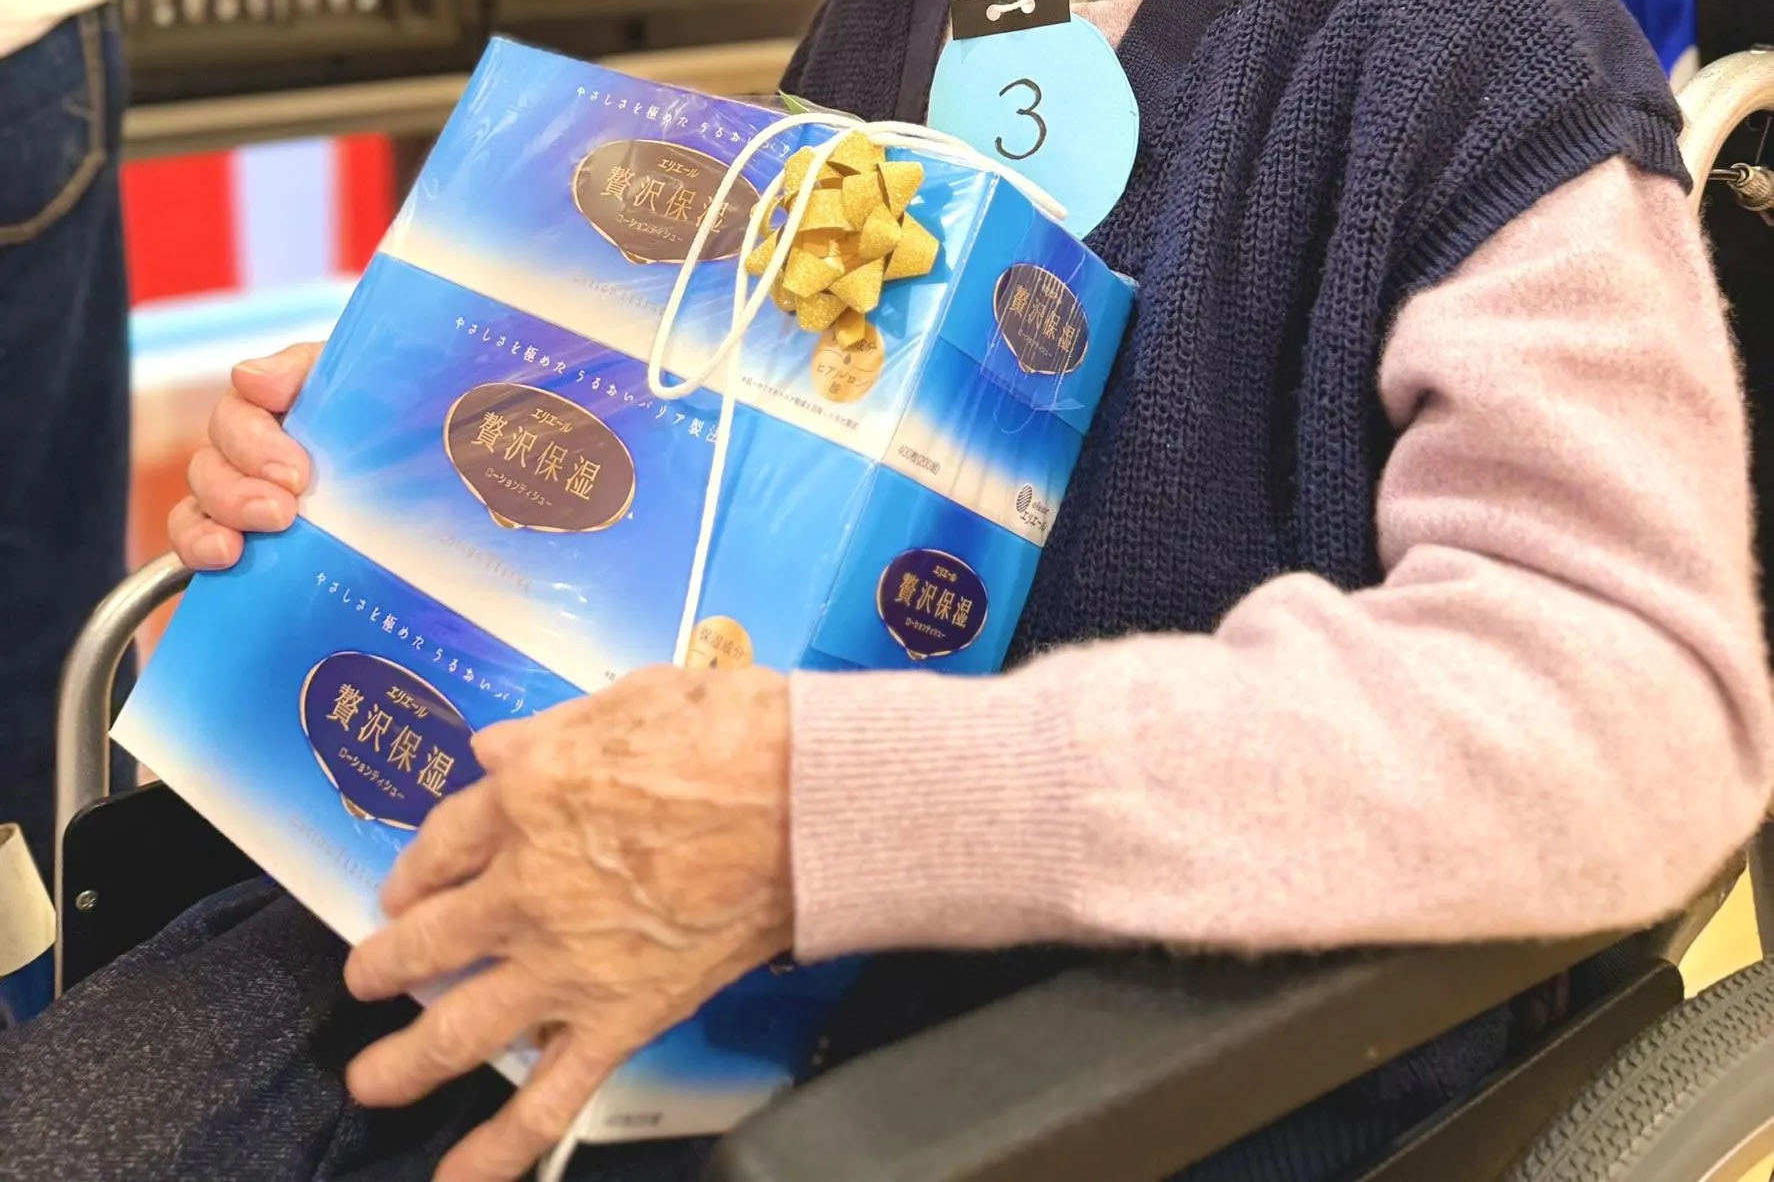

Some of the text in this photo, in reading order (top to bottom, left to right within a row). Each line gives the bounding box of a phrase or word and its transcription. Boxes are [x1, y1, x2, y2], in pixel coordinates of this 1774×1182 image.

[994, 78, 1047, 160] 3
[657, 158, 700, 179] エリエール
[455, 316, 567, 374] やさしさを極めた
[530, 407, 574, 434] エリエール
[471, 410, 601, 501] 贅沢保湿
[485, 467, 553, 508] ローションティシュー
[894, 571, 973, 629] 贅沢保湿
[315, 571, 538, 716] やさしさを極めた うるおいバリ
[386, 685, 430, 719] エリエール
[326, 683, 455, 798] 贅沢保湿
[337, 746, 406, 800] ローションティシュー
